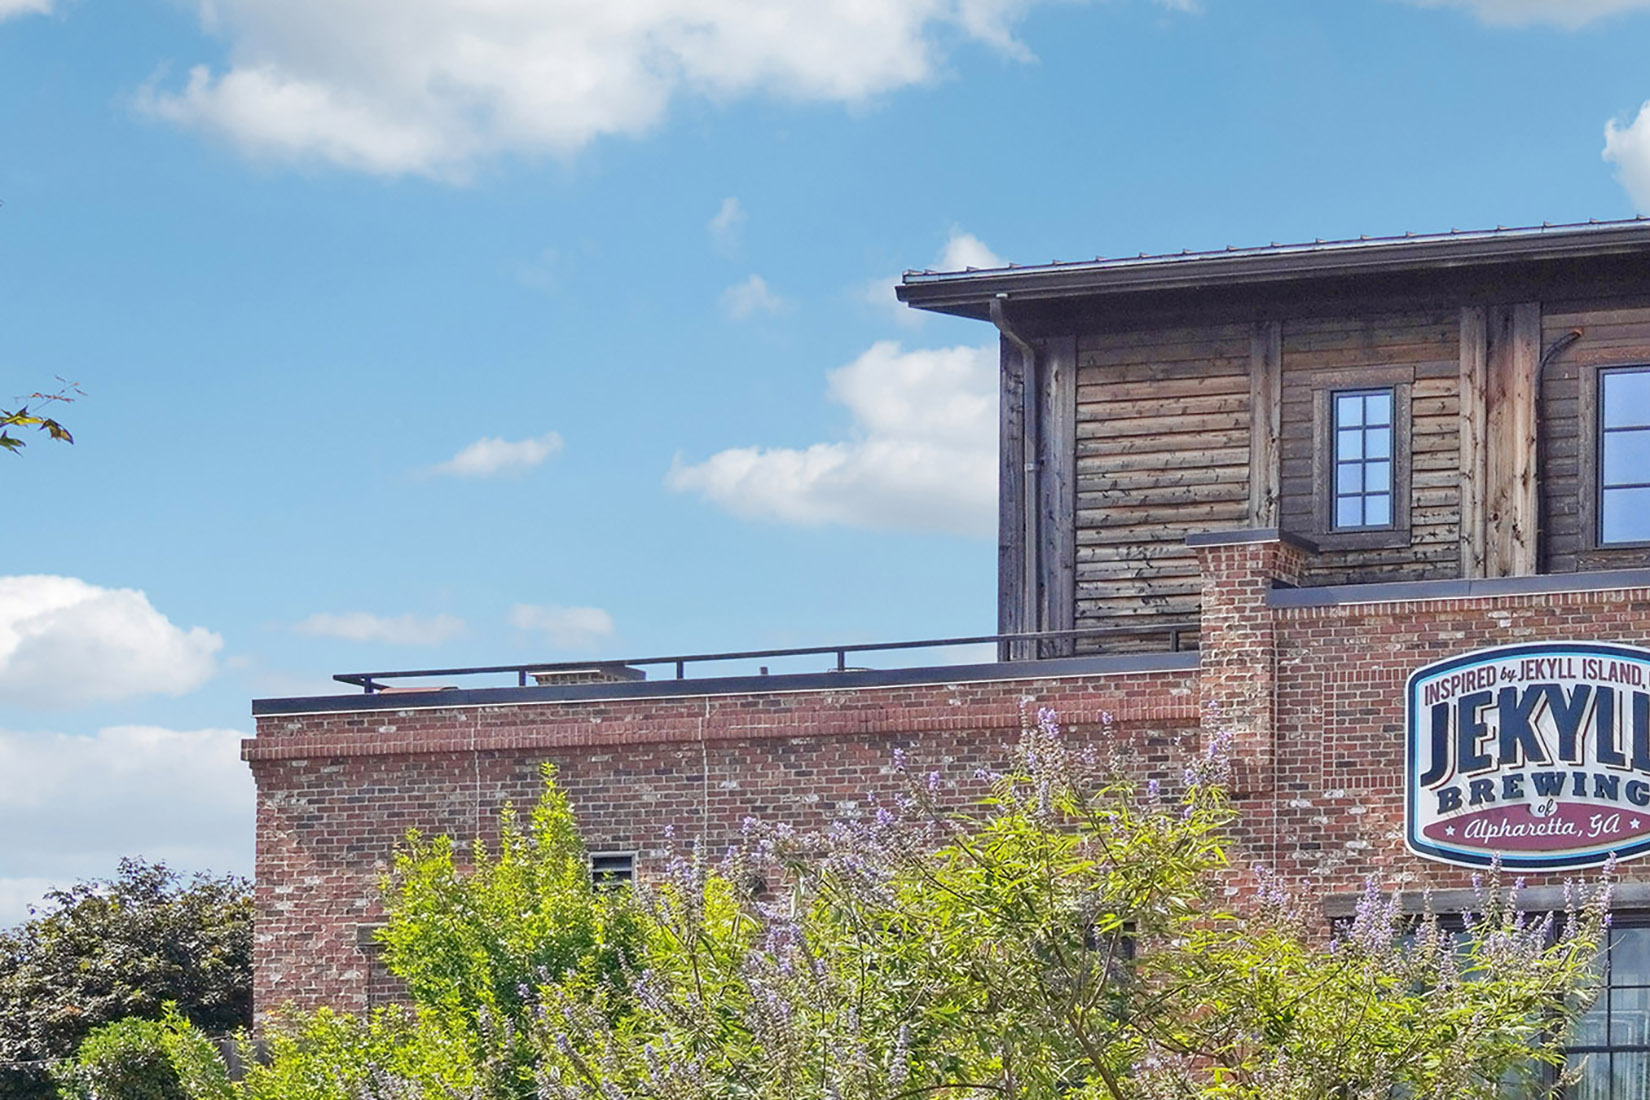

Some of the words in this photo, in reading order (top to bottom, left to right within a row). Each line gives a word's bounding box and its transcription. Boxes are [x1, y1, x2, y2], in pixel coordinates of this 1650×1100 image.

[1424, 665, 1497, 706] INSPIRED
[1500, 666, 1518, 682] by
[1518, 658, 1576, 682] JEKYLL
[1582, 658, 1646, 689] ISLAND,
[1437, 771, 1650, 815] BREWING
[1537, 799, 1555, 817] of
[1464, 818, 1583, 844] Alpharetta,
[1587, 813, 1621, 838] GA
